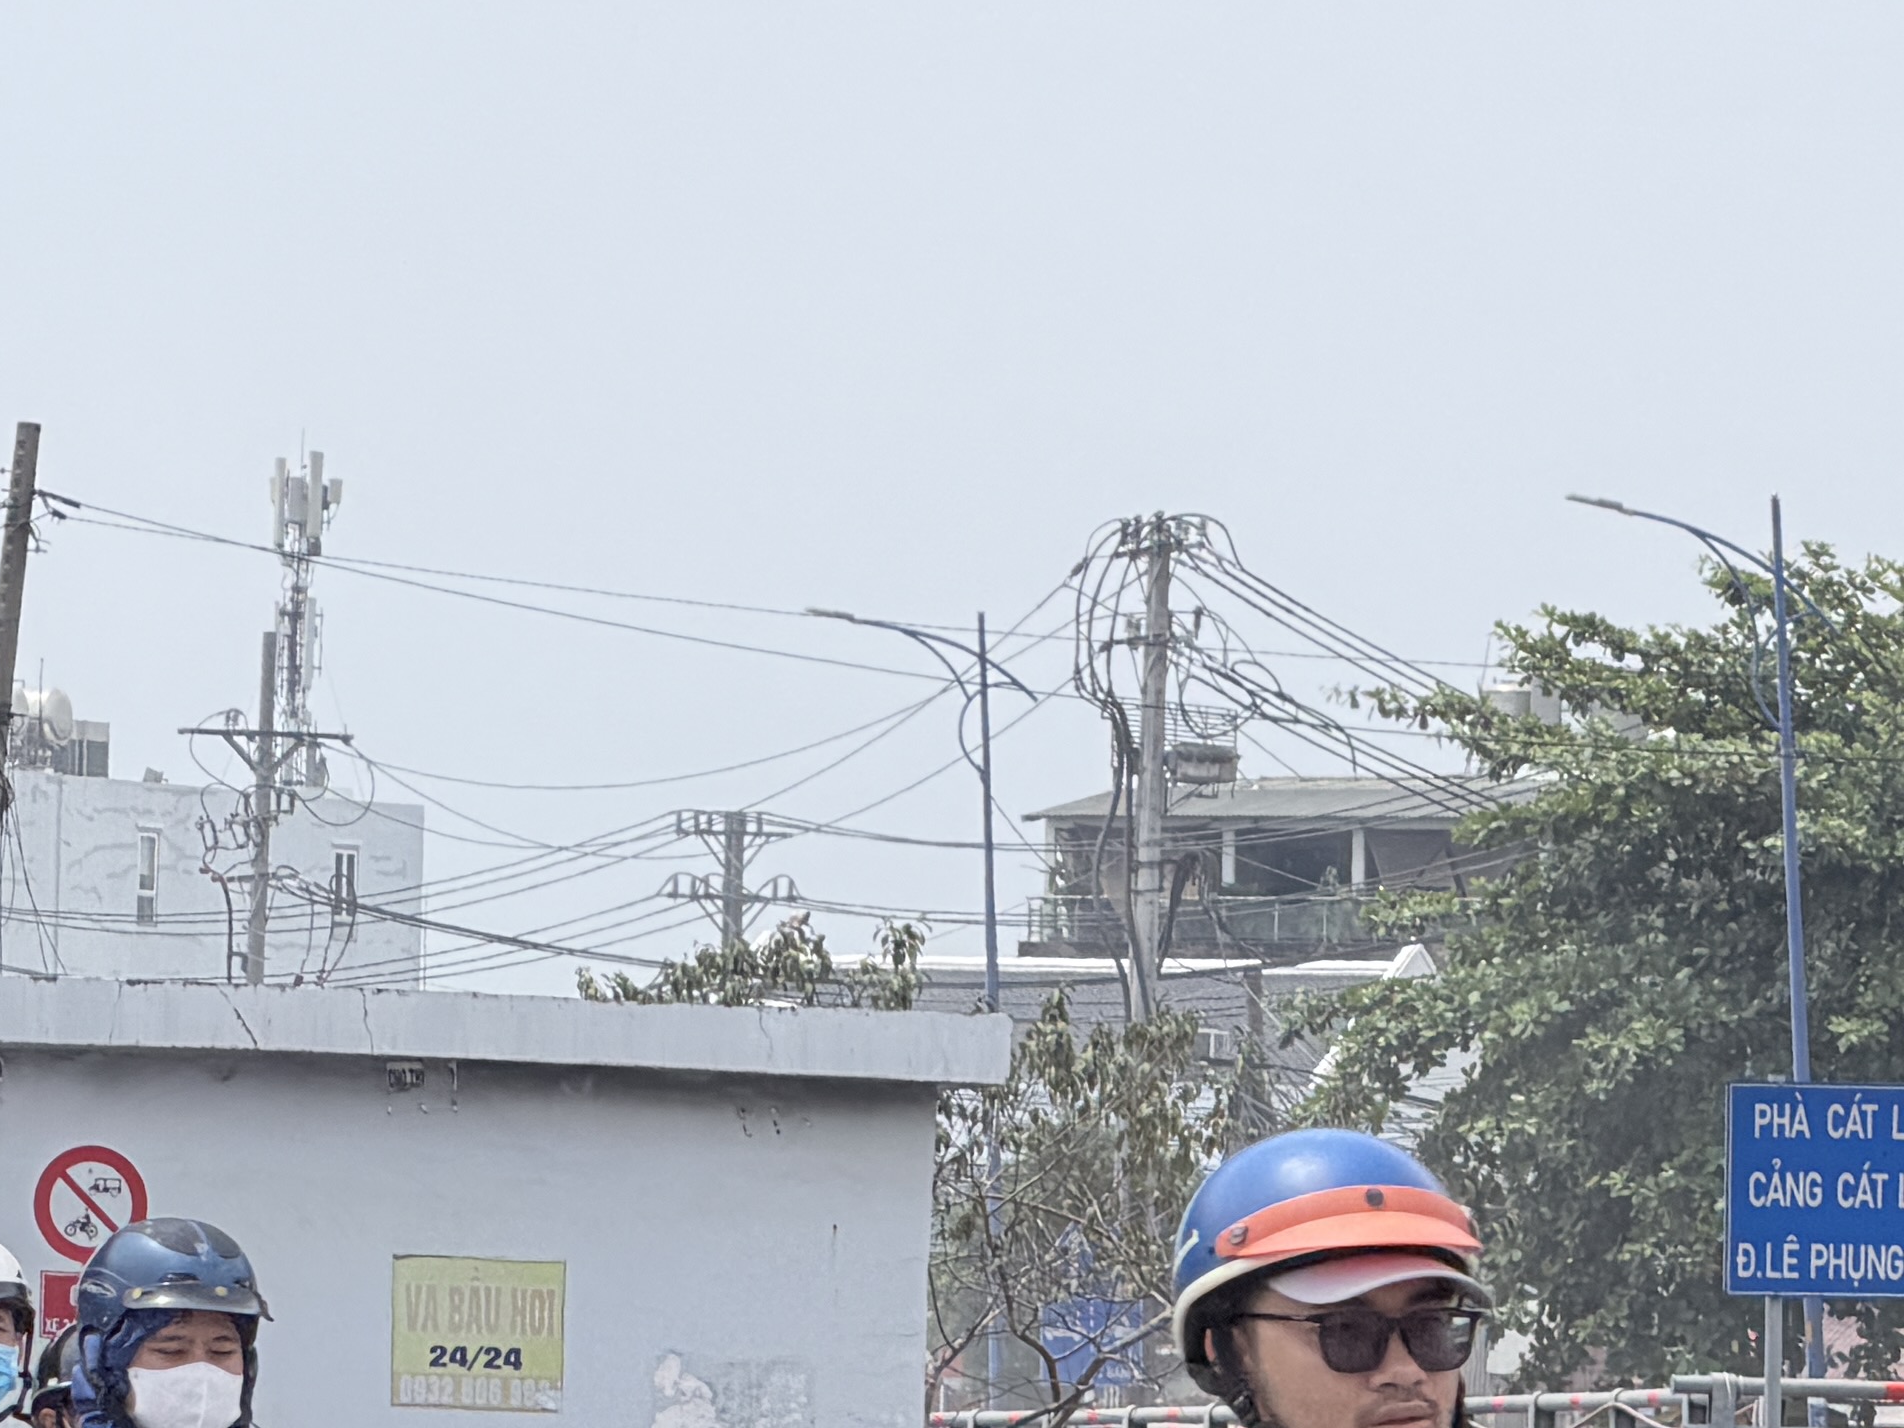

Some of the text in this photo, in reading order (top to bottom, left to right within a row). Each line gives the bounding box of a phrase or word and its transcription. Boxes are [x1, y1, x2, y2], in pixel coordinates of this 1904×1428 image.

[1753, 1092, 1810, 1139] PHÀ
[1826, 1093, 1878, 1139] CÁT
[1748, 1158, 1823, 1207] CẢNG
[1837, 1161, 1888, 1208] CÁT
[1736, 1235, 1904, 1287] Đ.LÊ PHỤNG
[429, 1344, 523, 1371] 24/24
